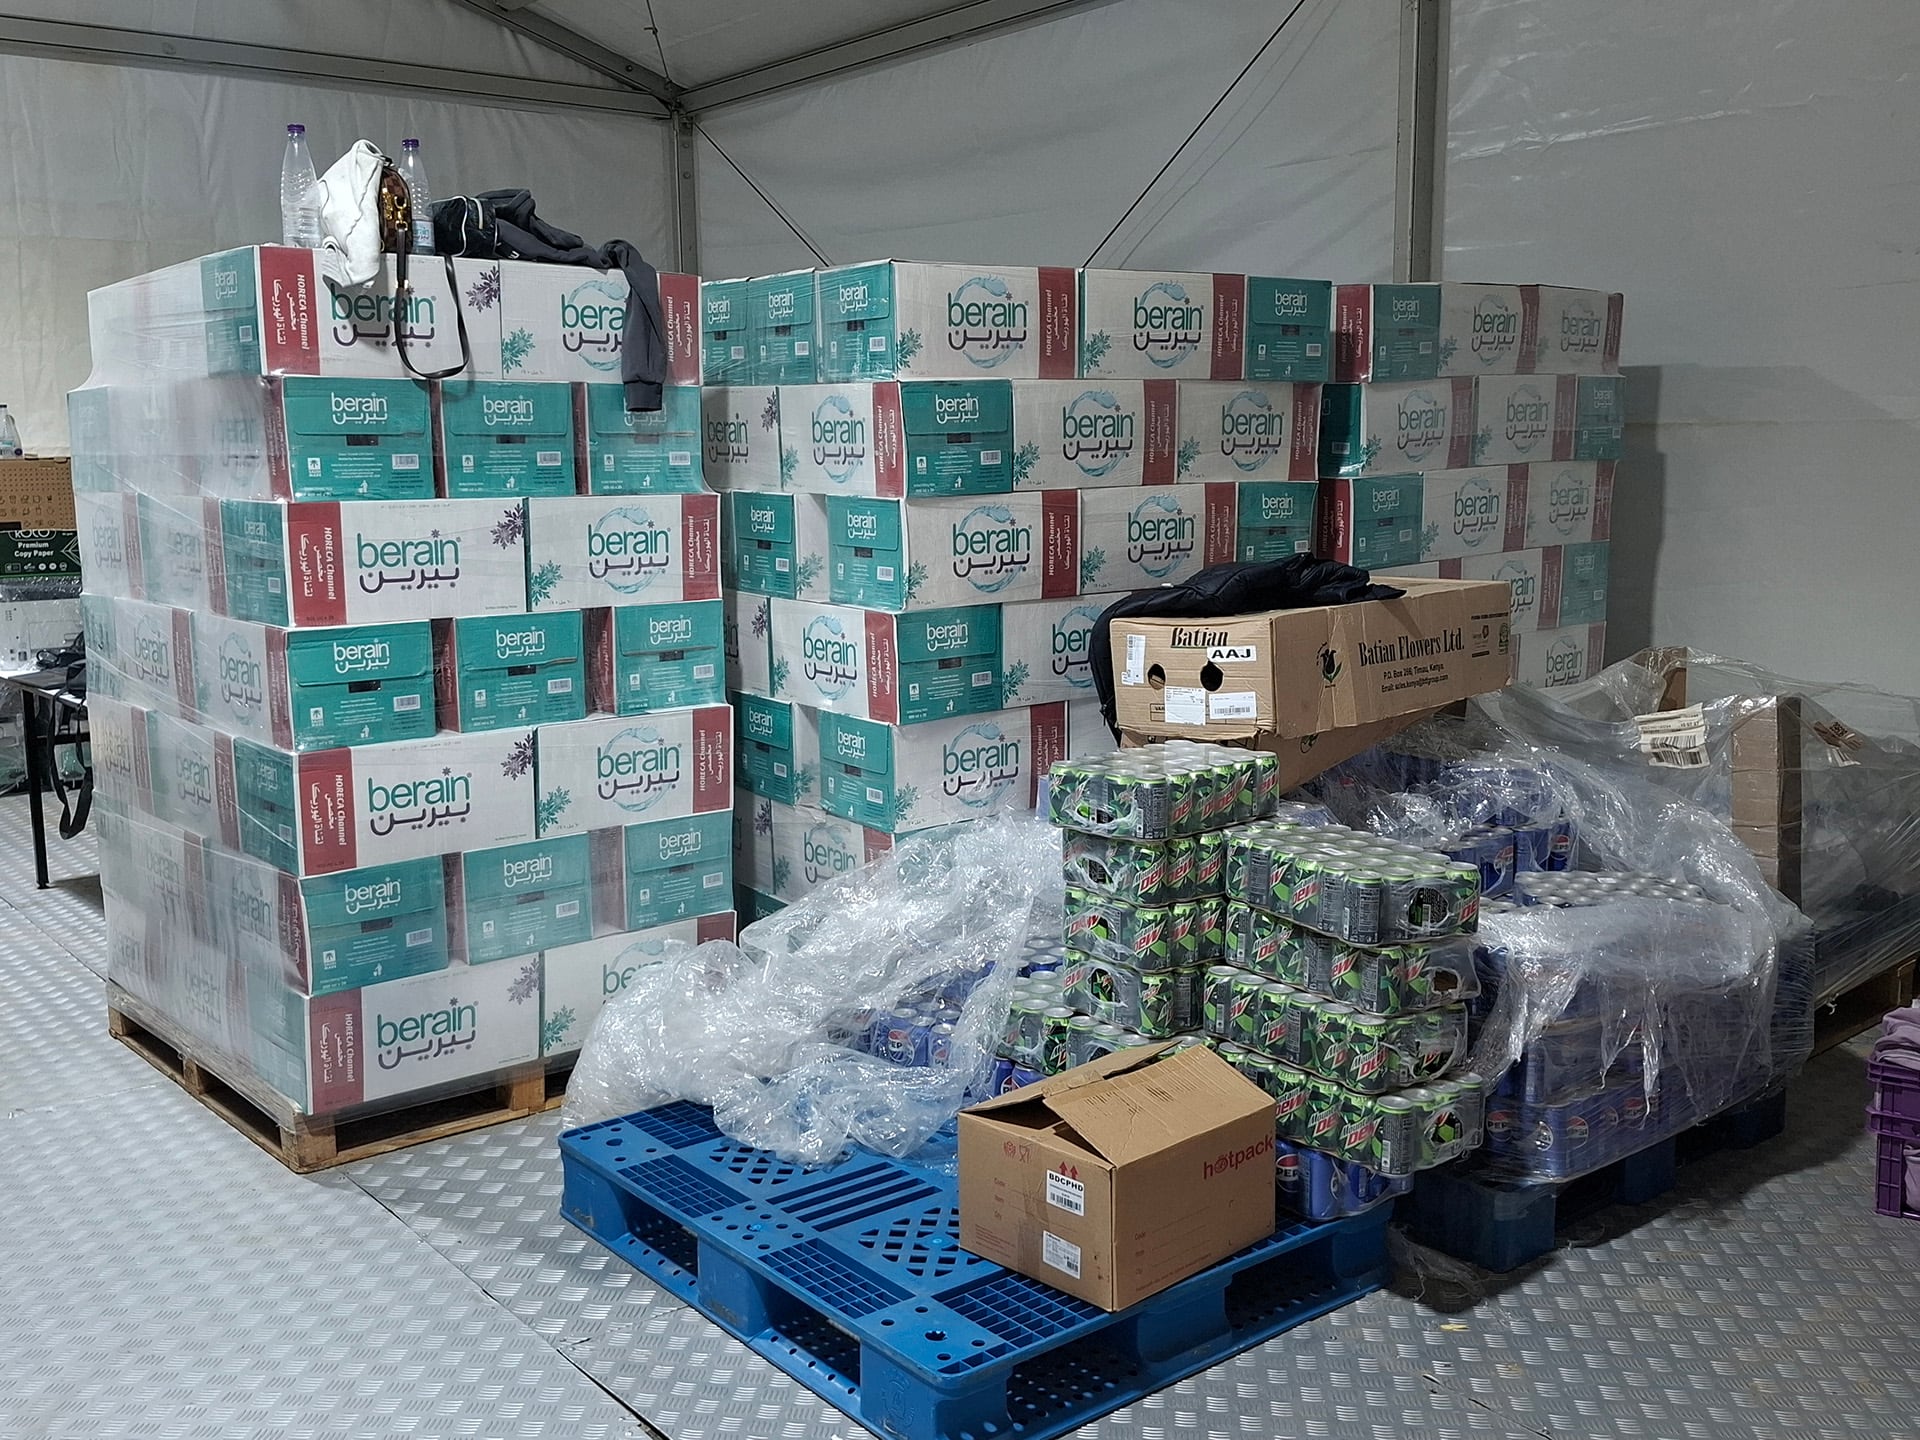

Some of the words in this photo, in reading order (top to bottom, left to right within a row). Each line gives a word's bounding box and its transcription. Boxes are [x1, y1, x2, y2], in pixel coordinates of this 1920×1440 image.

[272, 280, 284, 322] الهوريكا
[297, 274, 306, 310] HORECA
[331, 283, 434, 324] berain
[768, 288, 794, 308] berain
[839, 283, 868, 302] berain
[1275, 289, 1307, 306] berain
[286, 292, 299, 330] مخصص
[562, 294, 625, 329] bera
[707, 296, 730, 314] berain
[948, 291, 1028, 328] berain
[1134, 296, 1202, 331] berain
[1392, 296, 1420, 314] berain
[277, 322, 286, 344] لقناة
[300, 312, 310, 350] Channel
[1473, 307, 1516, 335] berain
[1562, 308, 1601, 336] berain
[949, 328, 1026, 352] بيرين
[1134, 328, 1200, 352] بيرين
[1472, 333, 1516, 352] بيرين
[1561, 335, 1599, 352] بيرين
[331, 391, 388, 412] berain
[483, 396, 534, 415] berain
[936, 393, 978, 413] berain
[1507, 396, 1549, 423] berain
[332, 411, 388, 425] بيرين
[484, 414, 534, 426] بيرين
[812, 409, 864, 445] berain
[937, 410, 978, 424] بيرين
[1063, 405, 1134, 440] berain
[1222, 405, 1283, 438] berain
[1398, 402, 1446, 430] berain
[707, 413, 748, 444] berain
[1398, 430, 1444, 450] بيرين
[1506, 422, 1548, 440] بيرين
[709, 443, 749, 465] بيرين
[813, 443, 865, 466] بيرين
[1064, 440, 1133, 460] بيرين
[1222, 437, 1282, 456] بيرين
[1262, 494, 1294, 510] berain
[1372, 487, 1400, 504] berain
[1454, 488, 1500, 516] berain
[1551, 483, 1589, 507] berain
[750, 505, 775, 524] berain
[751, 520, 775, 533] بيرين
[848, 510, 876, 528] berain
[1128, 509, 1195, 542] berain
[1454, 514, 1499, 536] بيرين
[324, 527, 334, 562] HORECA
[588, 520, 670, 557] berain
[849, 525, 876, 540] بيرين
[953, 519, 1030, 555] berain
[14, 550, 32, 558] Copy
[34, 550, 54, 558] Paper
[299, 534, 312, 574] الهوريكا
[357, 529, 460, 570] berain
[1128, 540, 1194, 564] بيرين
[314, 546, 326, 582] مخصص
[589, 556, 670, 579] بيرين
[953, 553, 1030, 578] بيرين
[304, 576, 313, 596] لقناة
[326, 564, 336, 600] Channel
[359, 566, 460, 594] بيرين
[650, 615, 691, 634] berain
[926, 618, 968, 640] berain
[496, 627, 545, 648] berain
[650, 630, 692, 644] بيرين
[803, 626, 857, 665] berain
[927, 636, 968, 651] بيرين
[1052, 624, 1091, 654] ber
[1171, 628, 1228, 646] Batian
[1358, 640, 1396, 667] Batian
[1398, 635, 1441, 660] Flowers
[1443, 628, 1464, 653] Ltd.
[334, 639, 390, 661] berain
[497, 644, 546, 659] بيرين
[1212, 648, 1251, 659] AAJ
[1546, 649, 1582, 673] berain
[335, 659, 390, 674] بيرين
[804, 660, 857, 687] بيرين
[750, 709, 773, 728] berain
[838, 727, 866, 746] berain
[598, 738, 680, 779] berain
[838, 742, 866, 758] بيرين
[944, 734, 1020, 774] berain
[336, 774, 344, 809] HORECA
[368, 767, 470, 812] berain
[598, 770, 680, 800] بيرين
[944, 766, 1018, 796] بيرين
[310, 782, 322, 824] الهوريكا
[324, 793, 337, 830] مخصص
[338, 810, 346, 846] Channel
[370, 803, 470, 836] بيرين
[314, 824, 324, 844] لقناة
[660, 829, 700, 850] berain
[660, 843, 700, 860] بيرين
[804, 831, 856, 868] berain
[504, 853, 552, 876] berain
[345, 877, 400, 902] berain
[504, 868, 552, 888] بيرين
[346, 896, 400, 914] بيرين
[345, 1014, 353, 1047] HORECA
[378, 998, 476, 1048] berain
[378, 1028, 476, 1069] بيرين
[346, 1048, 355, 1082] Channel
[1204, 1134, 1275, 1182] hotpack
[1048, 1172, 1084, 1192] BDCPHD
